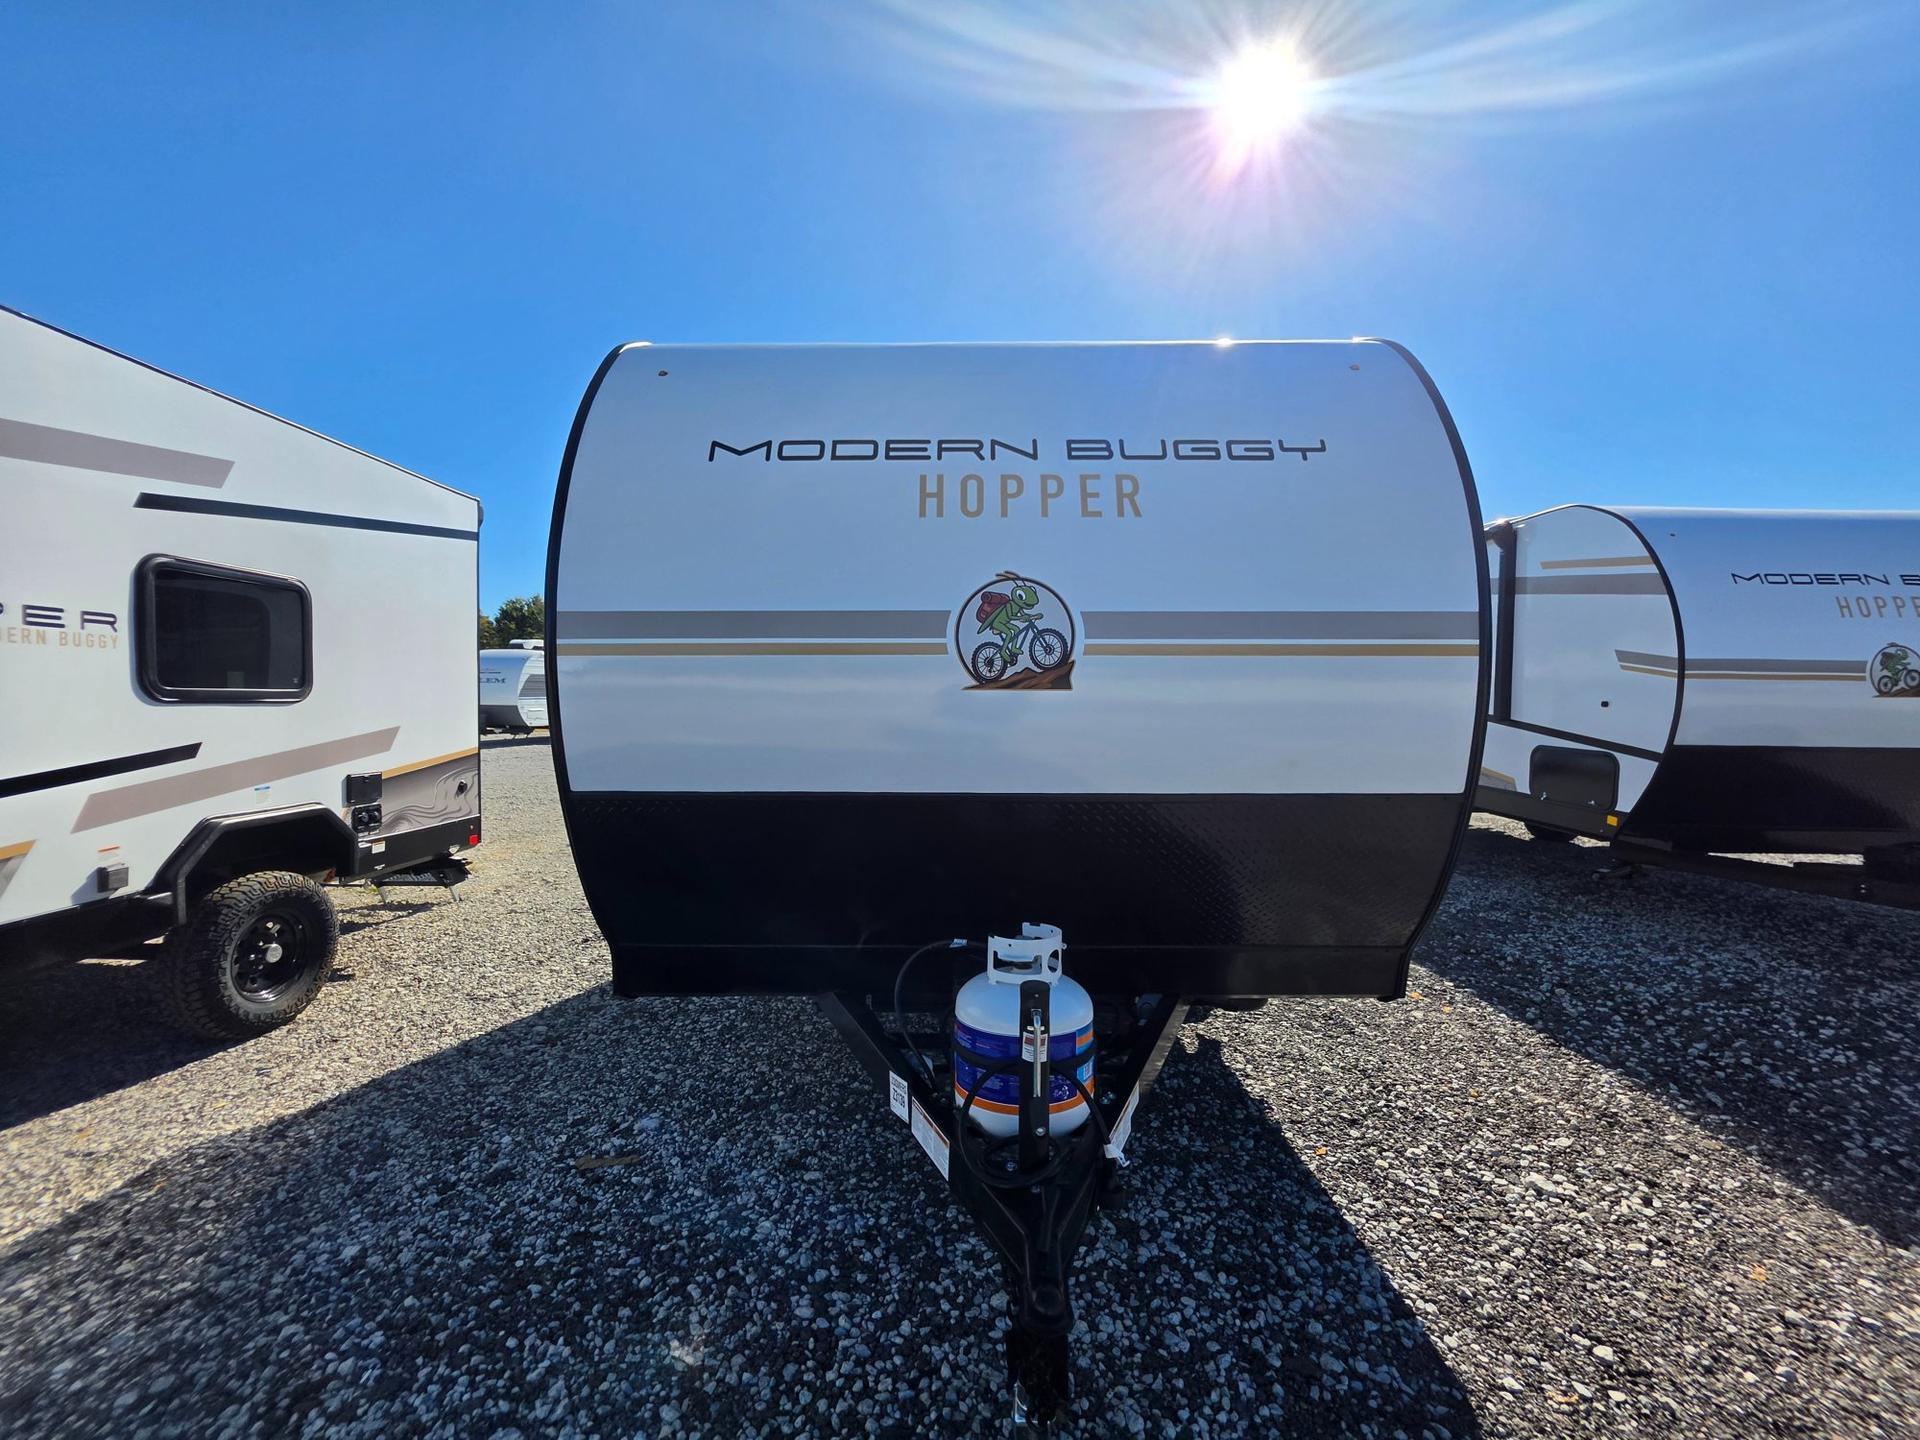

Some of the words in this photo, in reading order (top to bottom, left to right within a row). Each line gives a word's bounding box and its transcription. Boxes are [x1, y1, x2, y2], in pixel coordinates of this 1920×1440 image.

[708, 439, 1038, 462] MODERN
[1066, 438, 1327, 462] BUGGY
[918, 473, 1143, 518] HOPPER
[1731, 573, 1890, 586] MODERN
[0, 602, 117, 632] ER
[0, 627, 46, 645] ERN
[59, 631, 118, 649] BUGGY
